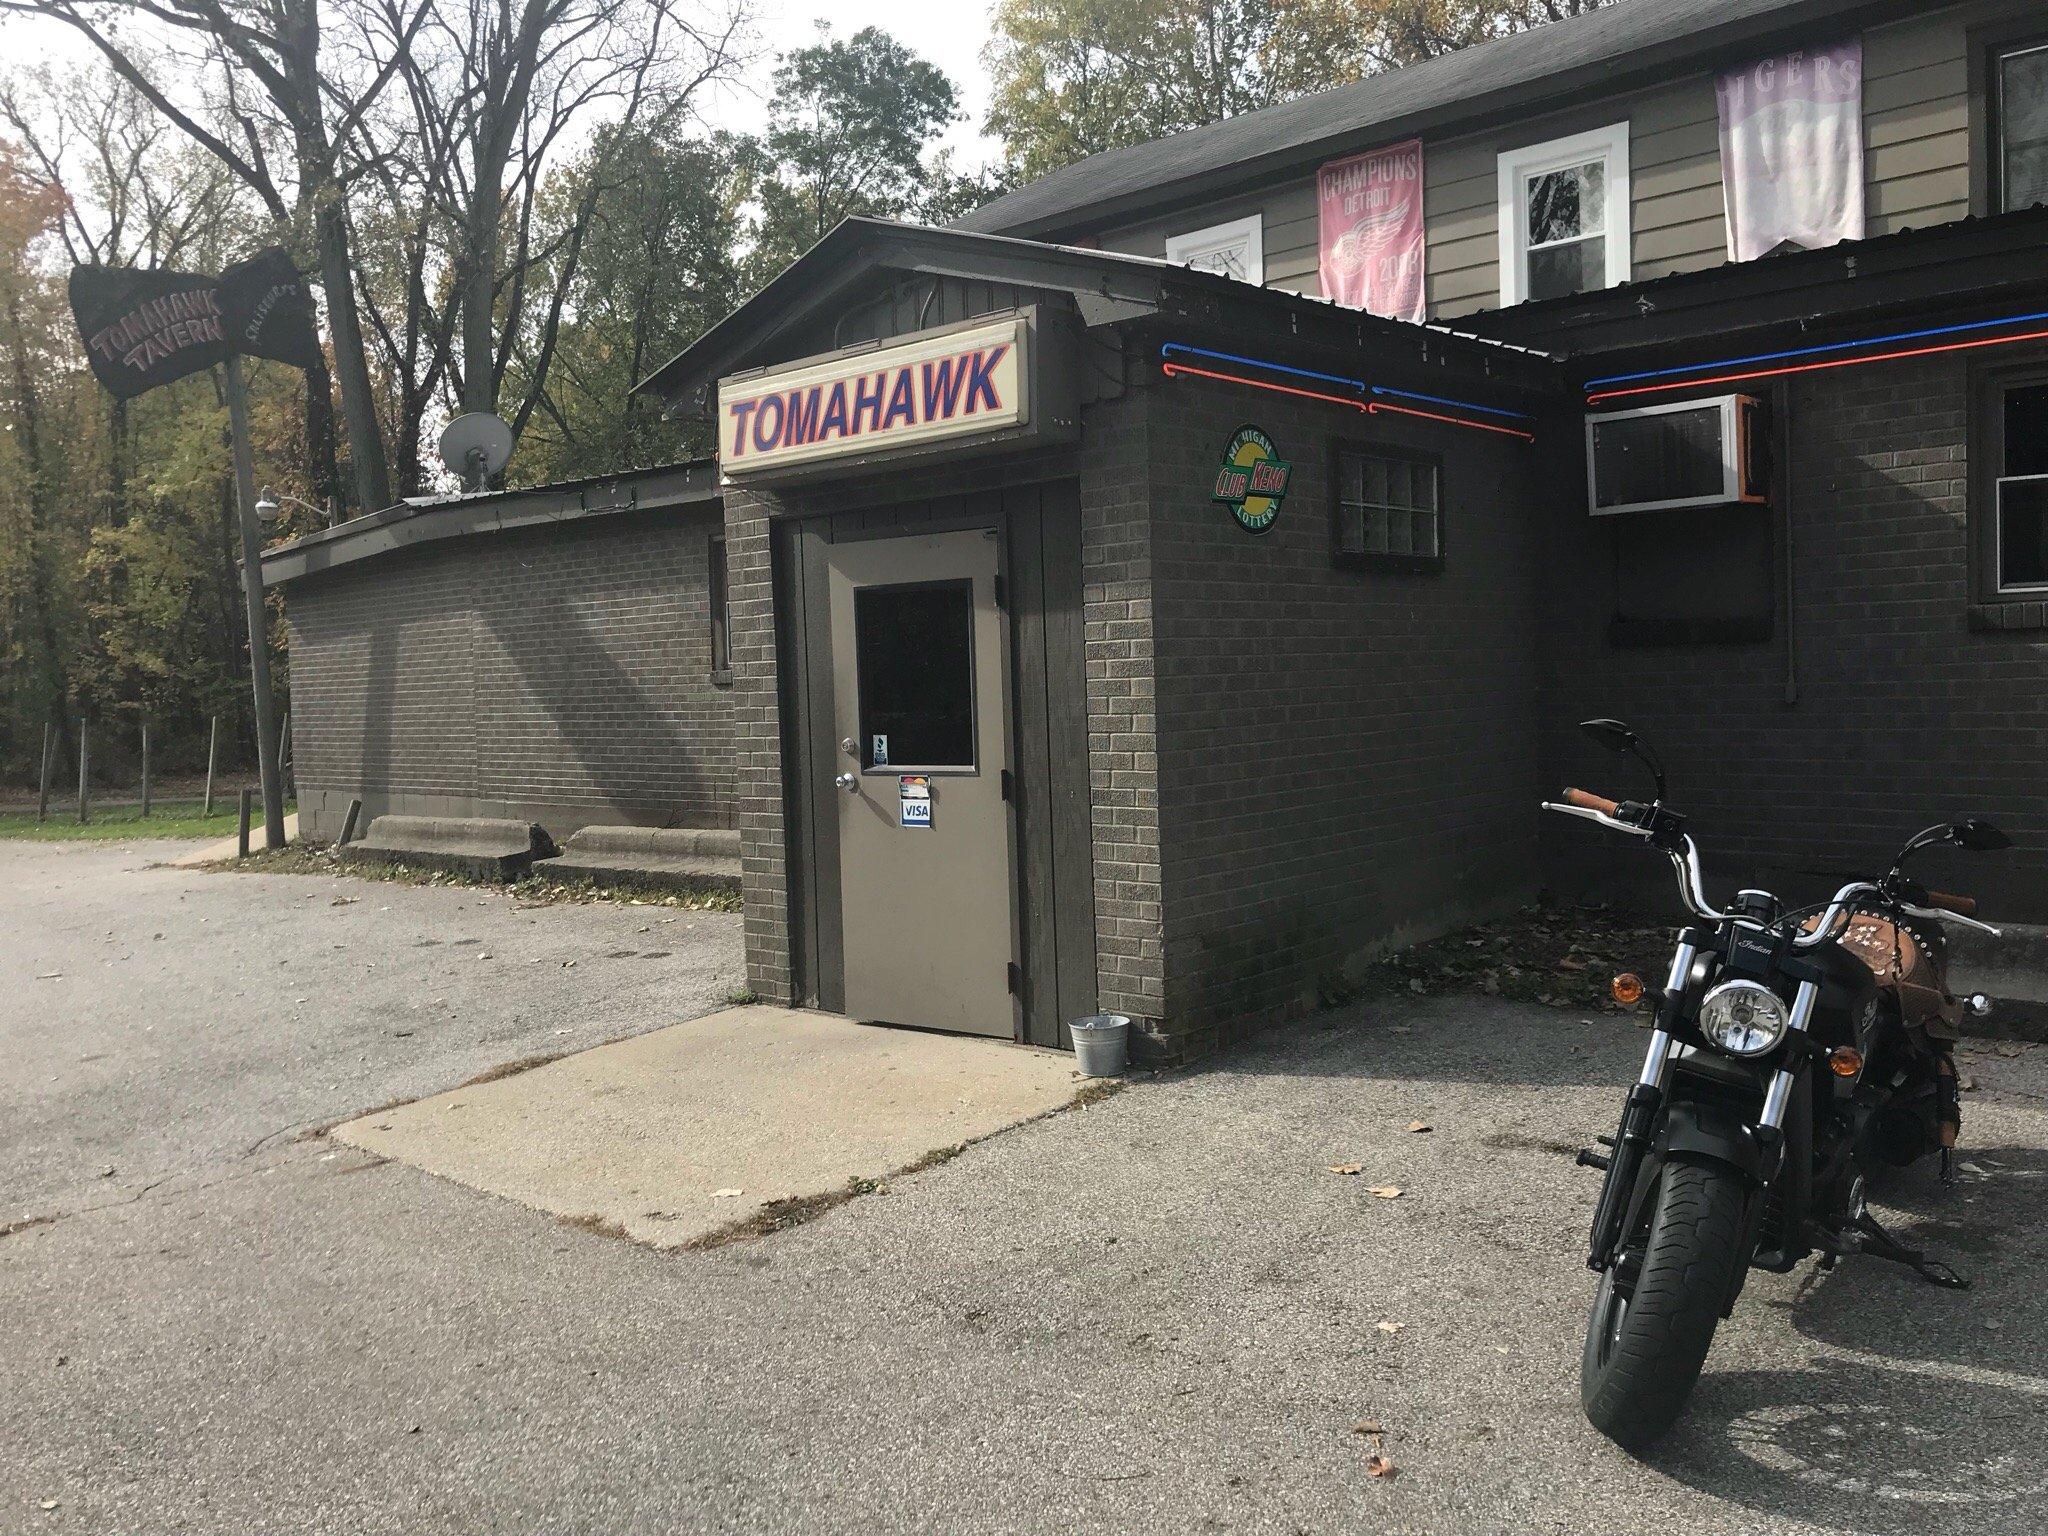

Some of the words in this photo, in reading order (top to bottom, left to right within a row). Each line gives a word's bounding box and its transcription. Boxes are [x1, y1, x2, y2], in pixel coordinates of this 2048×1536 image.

[1717, 49, 1858, 132] TIGERS
[1323, 153, 1417, 202] CHAMPIONS
[1344, 186, 1391, 216] DETROIT
[89, 287, 224, 362] TOMAHAWK
[122, 315, 225, 372] TAVERN
[729, 342, 1011, 458] TOMAHAWK
[1228, 429, 1272, 460] MICHIGAN
[1215, 467, 1247, 498] CLUB
[1250, 461, 1287, 493] KENO
[1236, 500, 1278, 527] LOTTERY
[905, 805, 929, 817] VISA
[1738, 938, 1772, 956] Indian
